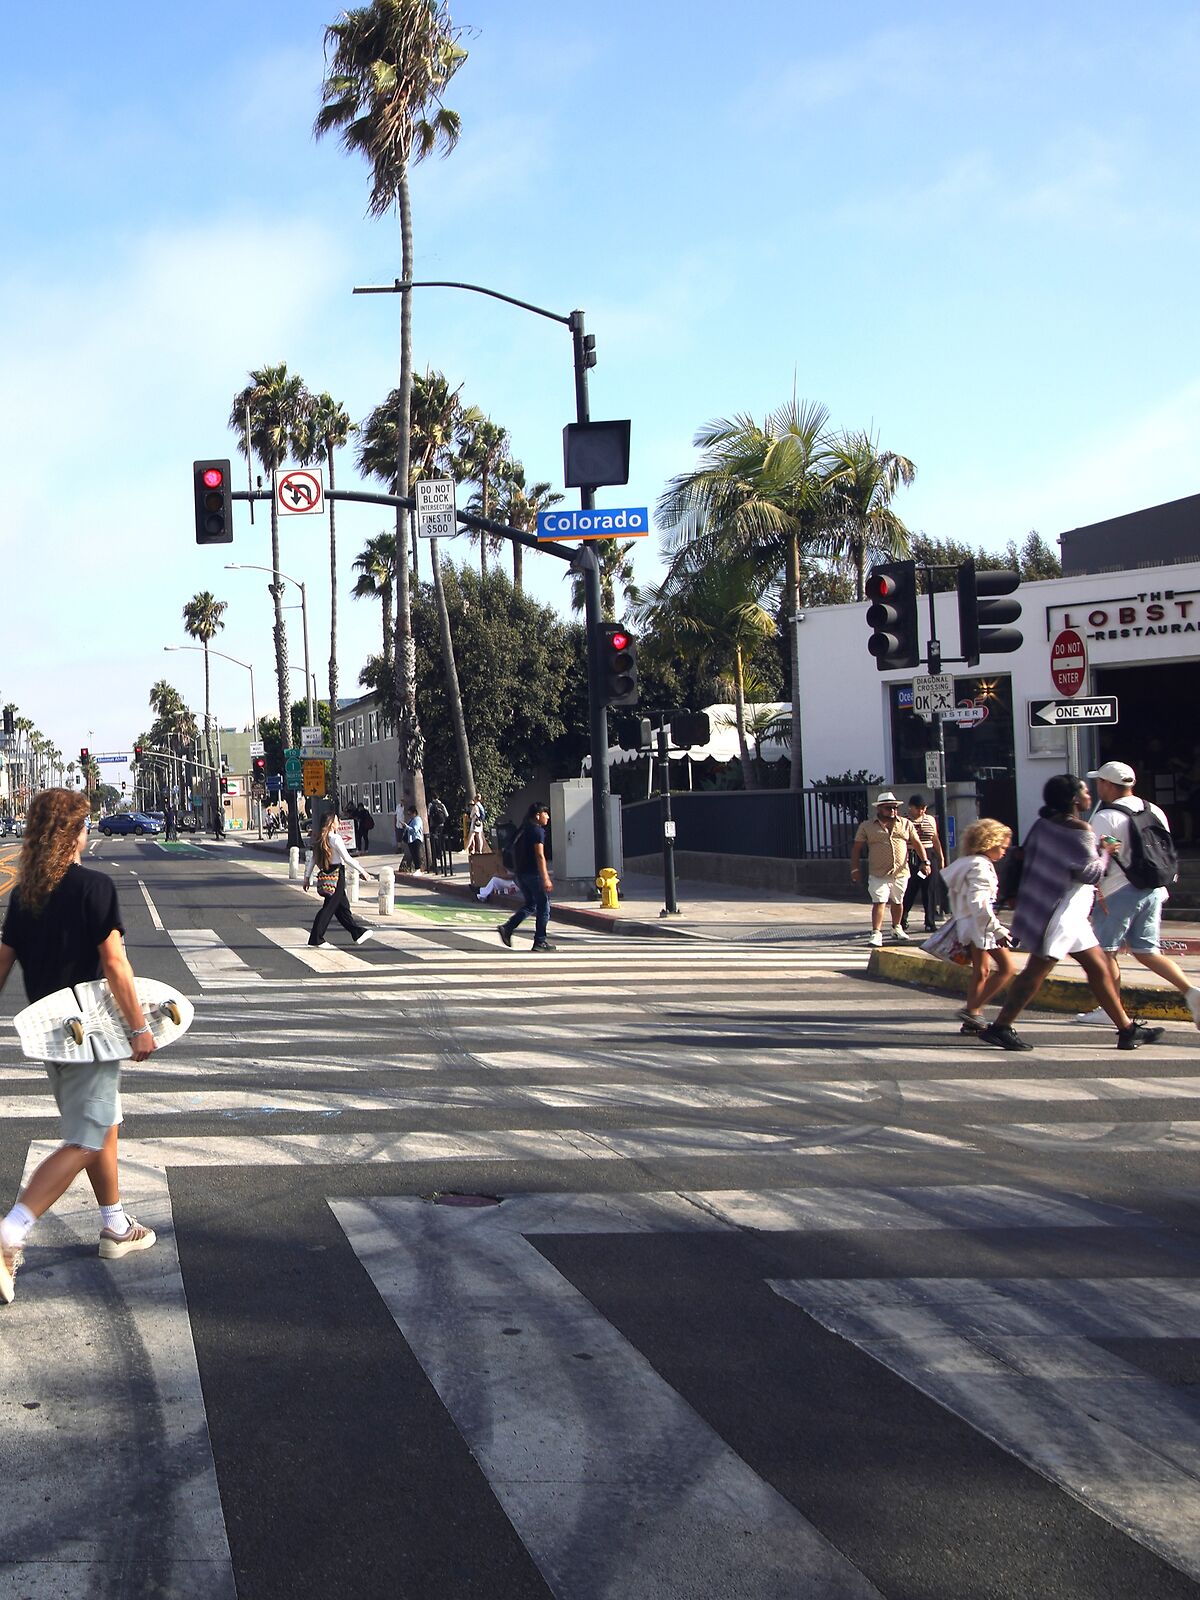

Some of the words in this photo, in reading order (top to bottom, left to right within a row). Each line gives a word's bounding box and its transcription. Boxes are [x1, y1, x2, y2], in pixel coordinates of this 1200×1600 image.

[420, 486, 431, 494] DO
[435, 485, 451, 493] NOT
[423, 494, 449, 503] BLOCK
[422, 515, 440, 523] FINES
[443, 514, 452, 522] TO
[543, 510, 642, 531] Colorado
[427, 524, 448, 534] $500
[1137, 590, 1175, 602] THE
[1095, 621, 1200, 641] RESTAURA
[1055, 644, 1065, 655] DO
[1067, 642, 1081, 653] NOT
[916, 676, 949, 685] DIAGONAL
[1058, 672, 1079, 684] ENTER
[917, 684, 949, 692] CROSSING
[915, 695, 930, 710] OK
[1056, 706, 1079, 718] ONE
[1083, 705, 1108, 717] WAY
